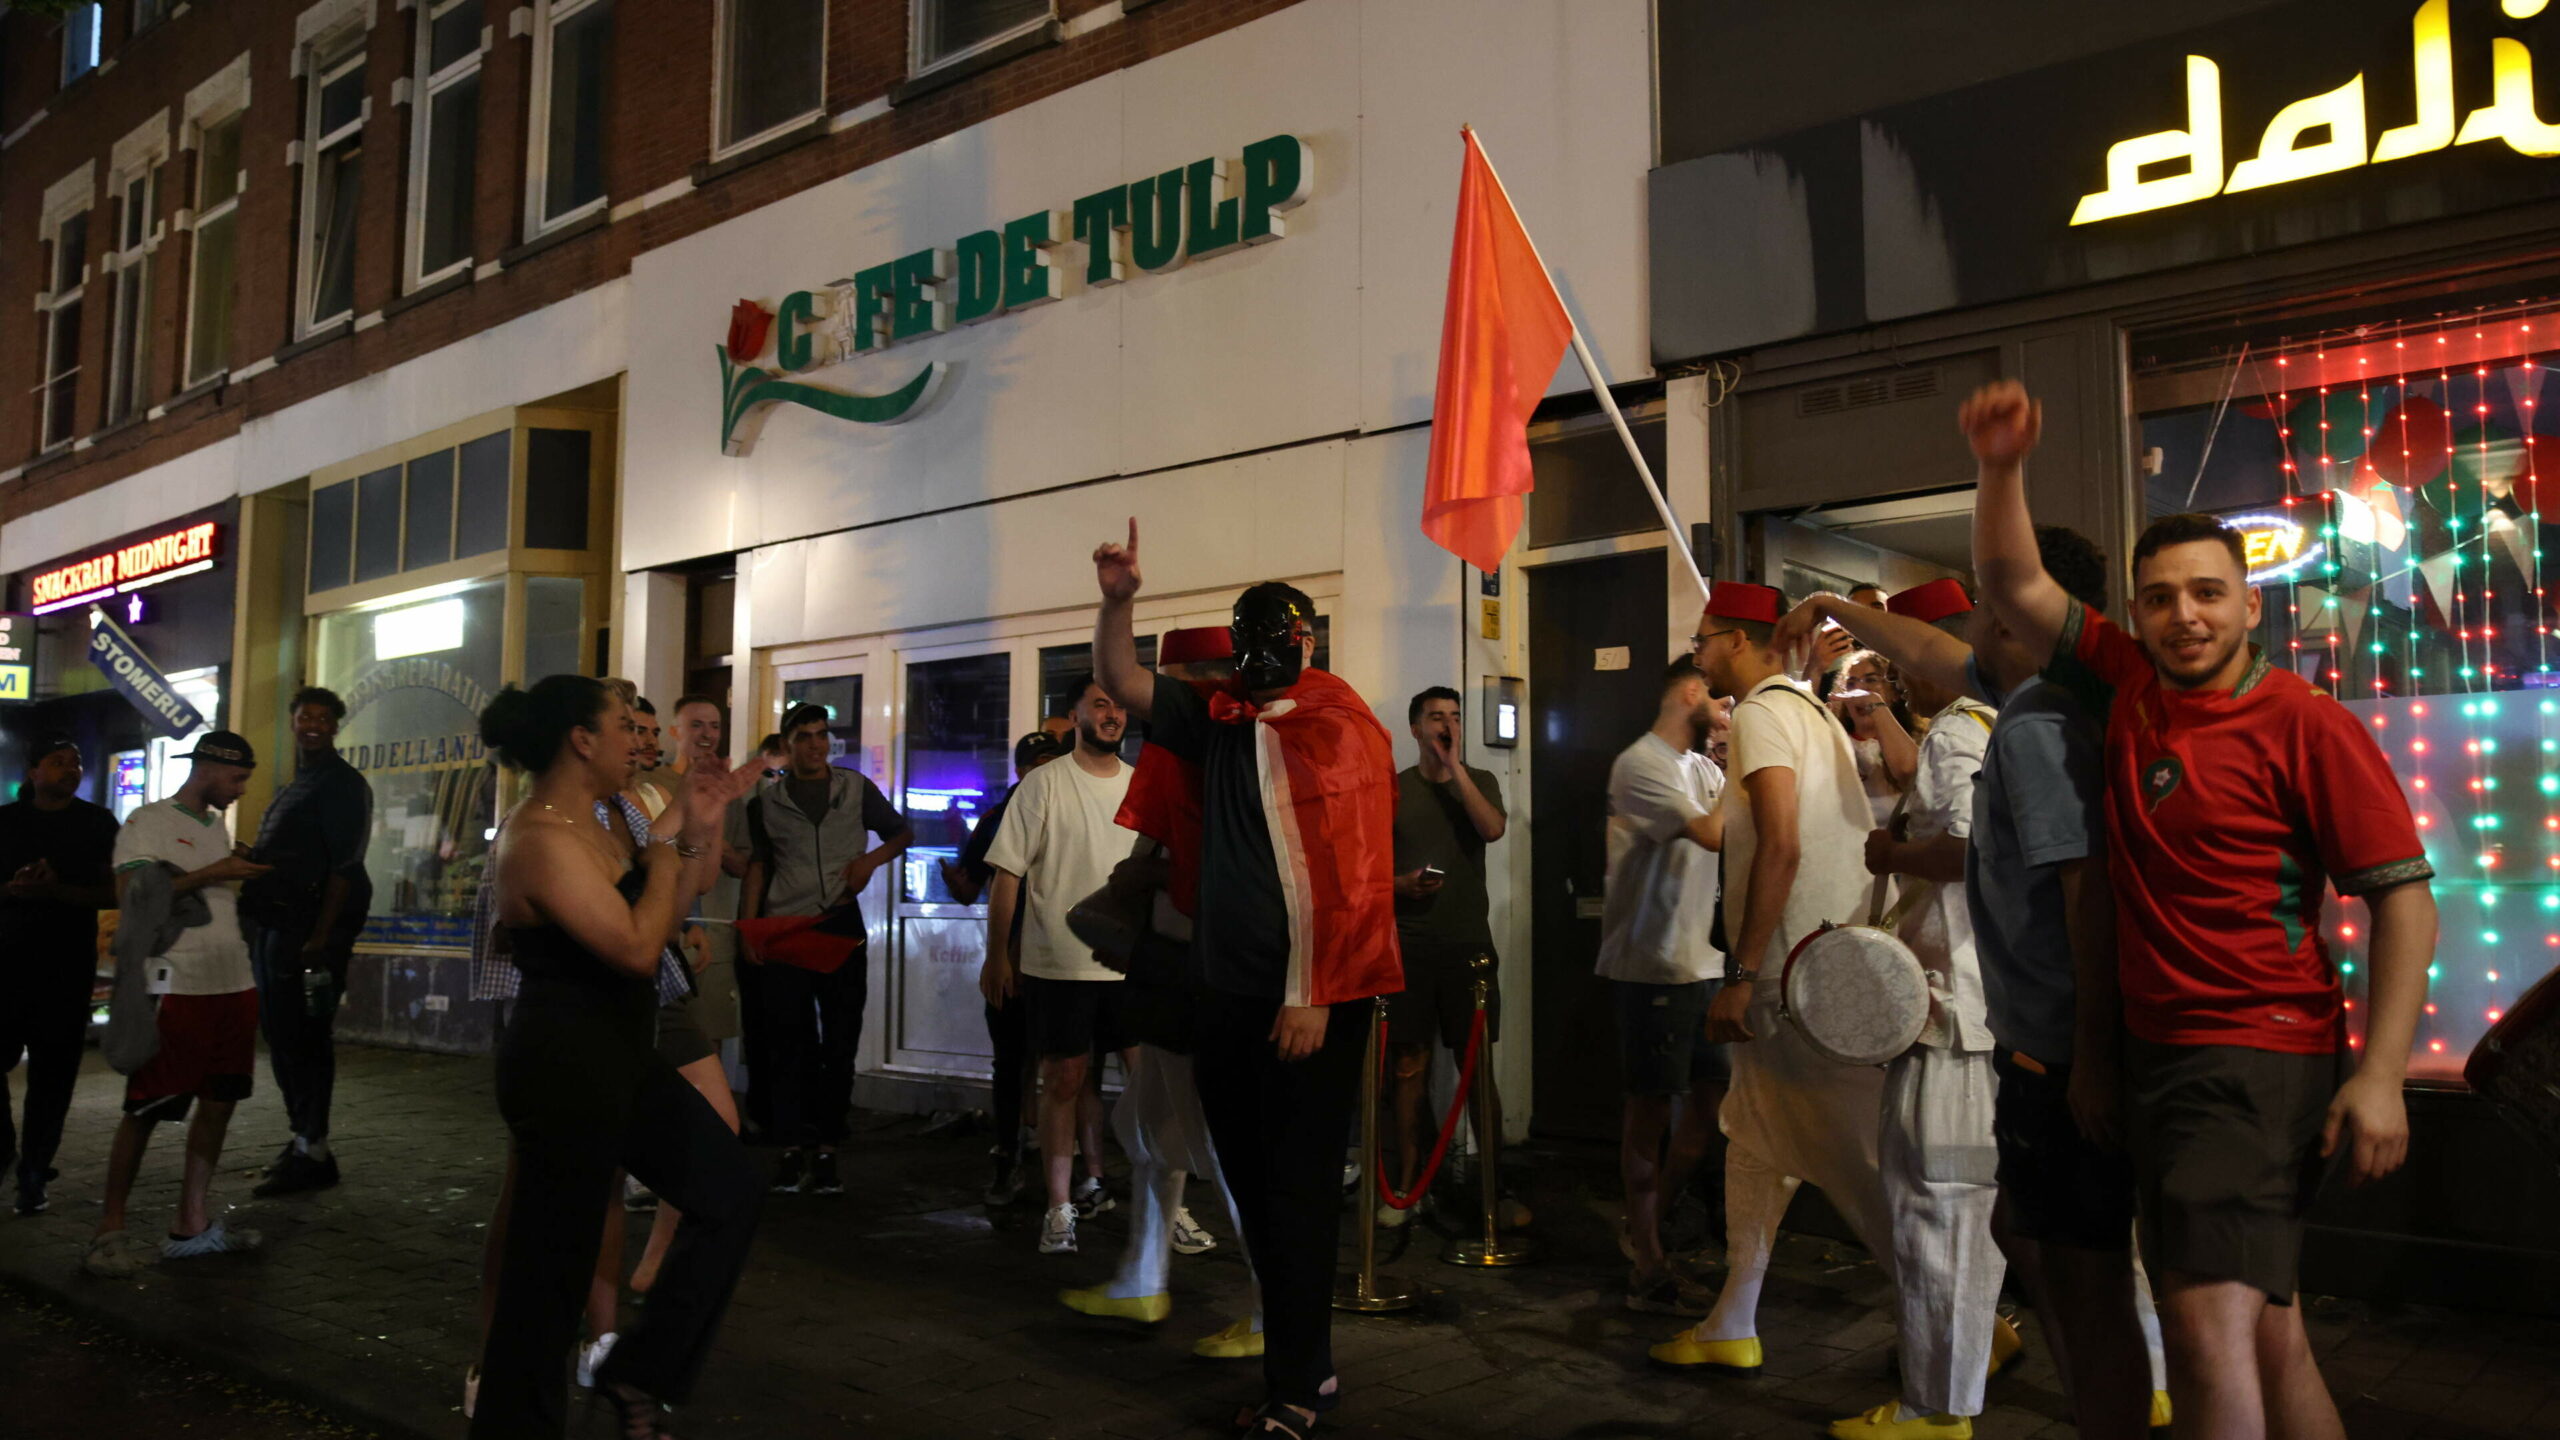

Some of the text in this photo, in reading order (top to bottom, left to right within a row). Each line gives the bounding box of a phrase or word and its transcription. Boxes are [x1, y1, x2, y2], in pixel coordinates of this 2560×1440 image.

[778, 134, 1306, 374] CFE DE TULP
[32, 521, 216, 605] SNACKBAR MIDNIGHT
[2244, 526, 2306, 565] EN
[92, 632, 193, 729] STOMERIJ
[337, 733, 486, 770] IDDELLAND
